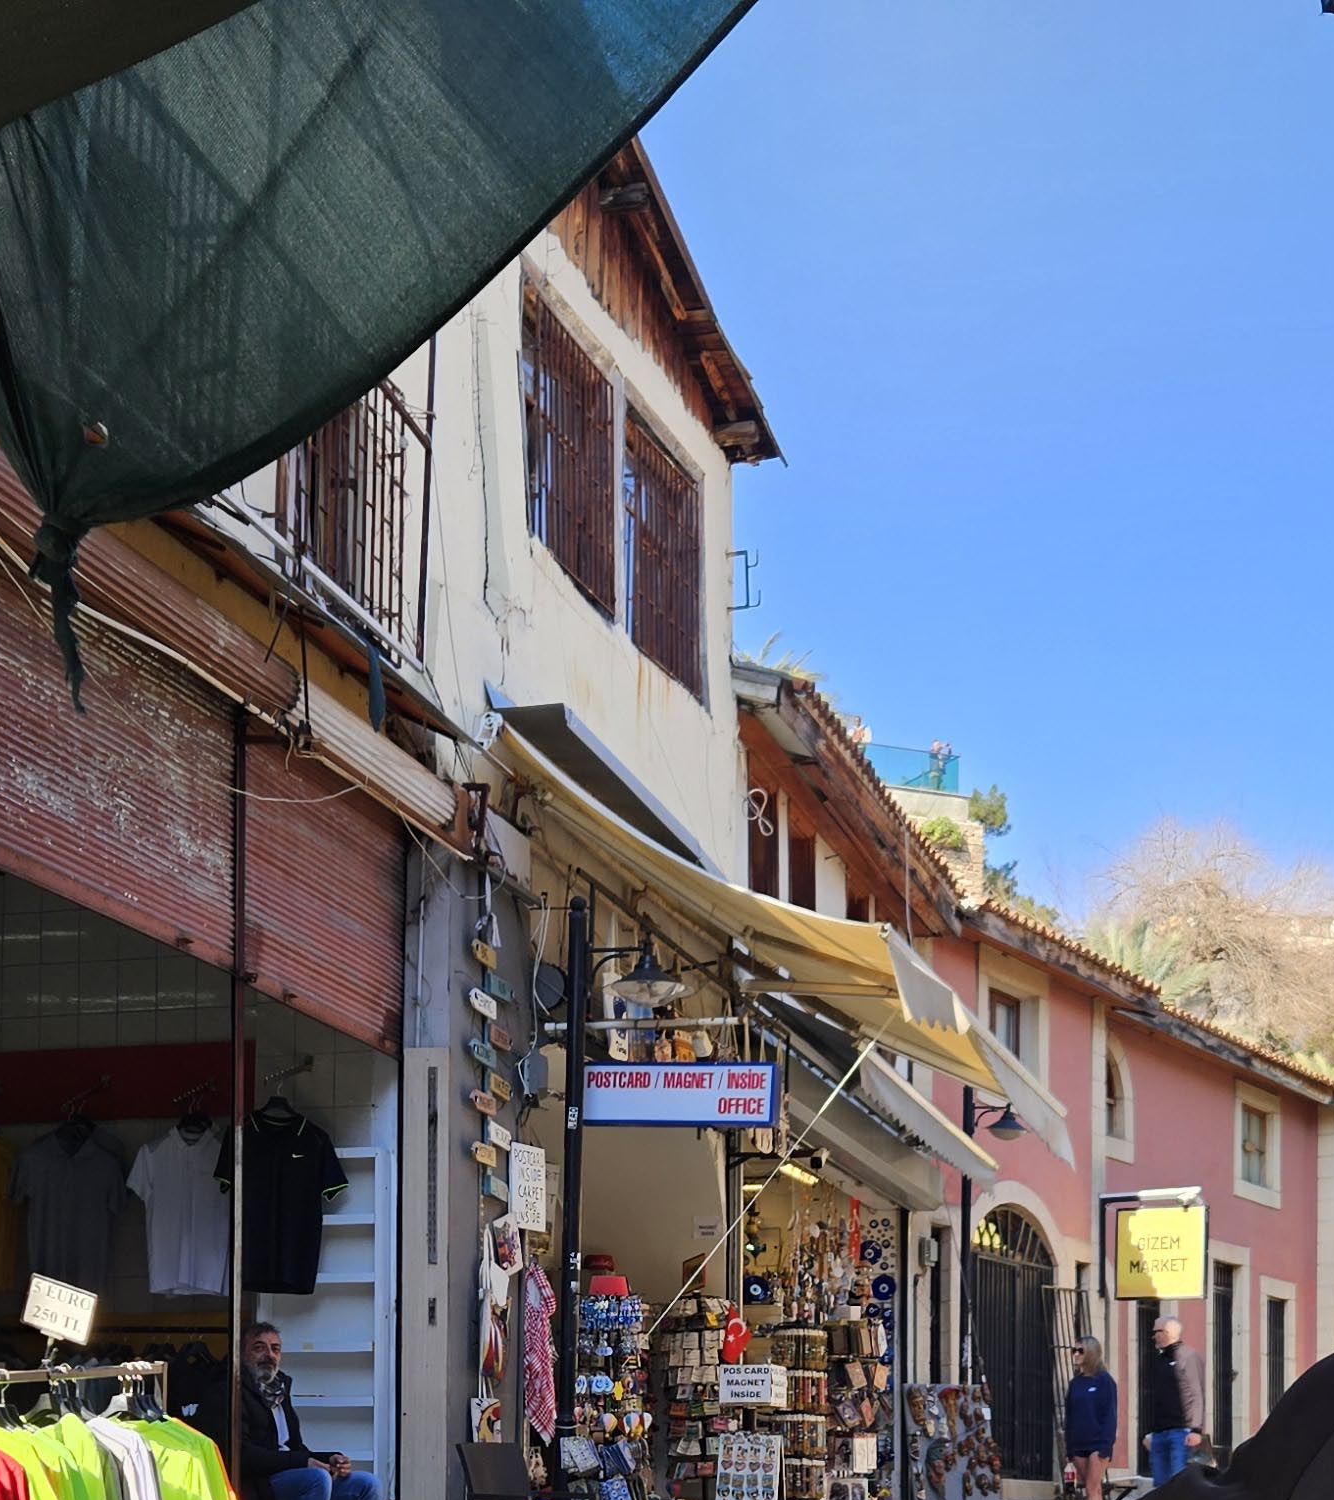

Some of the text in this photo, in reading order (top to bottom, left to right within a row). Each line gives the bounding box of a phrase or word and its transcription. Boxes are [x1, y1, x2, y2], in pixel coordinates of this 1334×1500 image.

[587, 1071, 651, 1089] POSTCARD
[663, 1071, 714, 1089] MAGNET
[718, 1097, 765, 1115] OFFICE
[518, 1184, 544, 1201] CARPET
[1129, 1258, 1189, 1274] MARKET
[32, 1280, 92, 1311] 5 EURO
[32, 1304, 82, 1333] 250 TL
[744, 1367, 770, 1375] CARD
[726, 1379, 766, 1387] MAGNET
